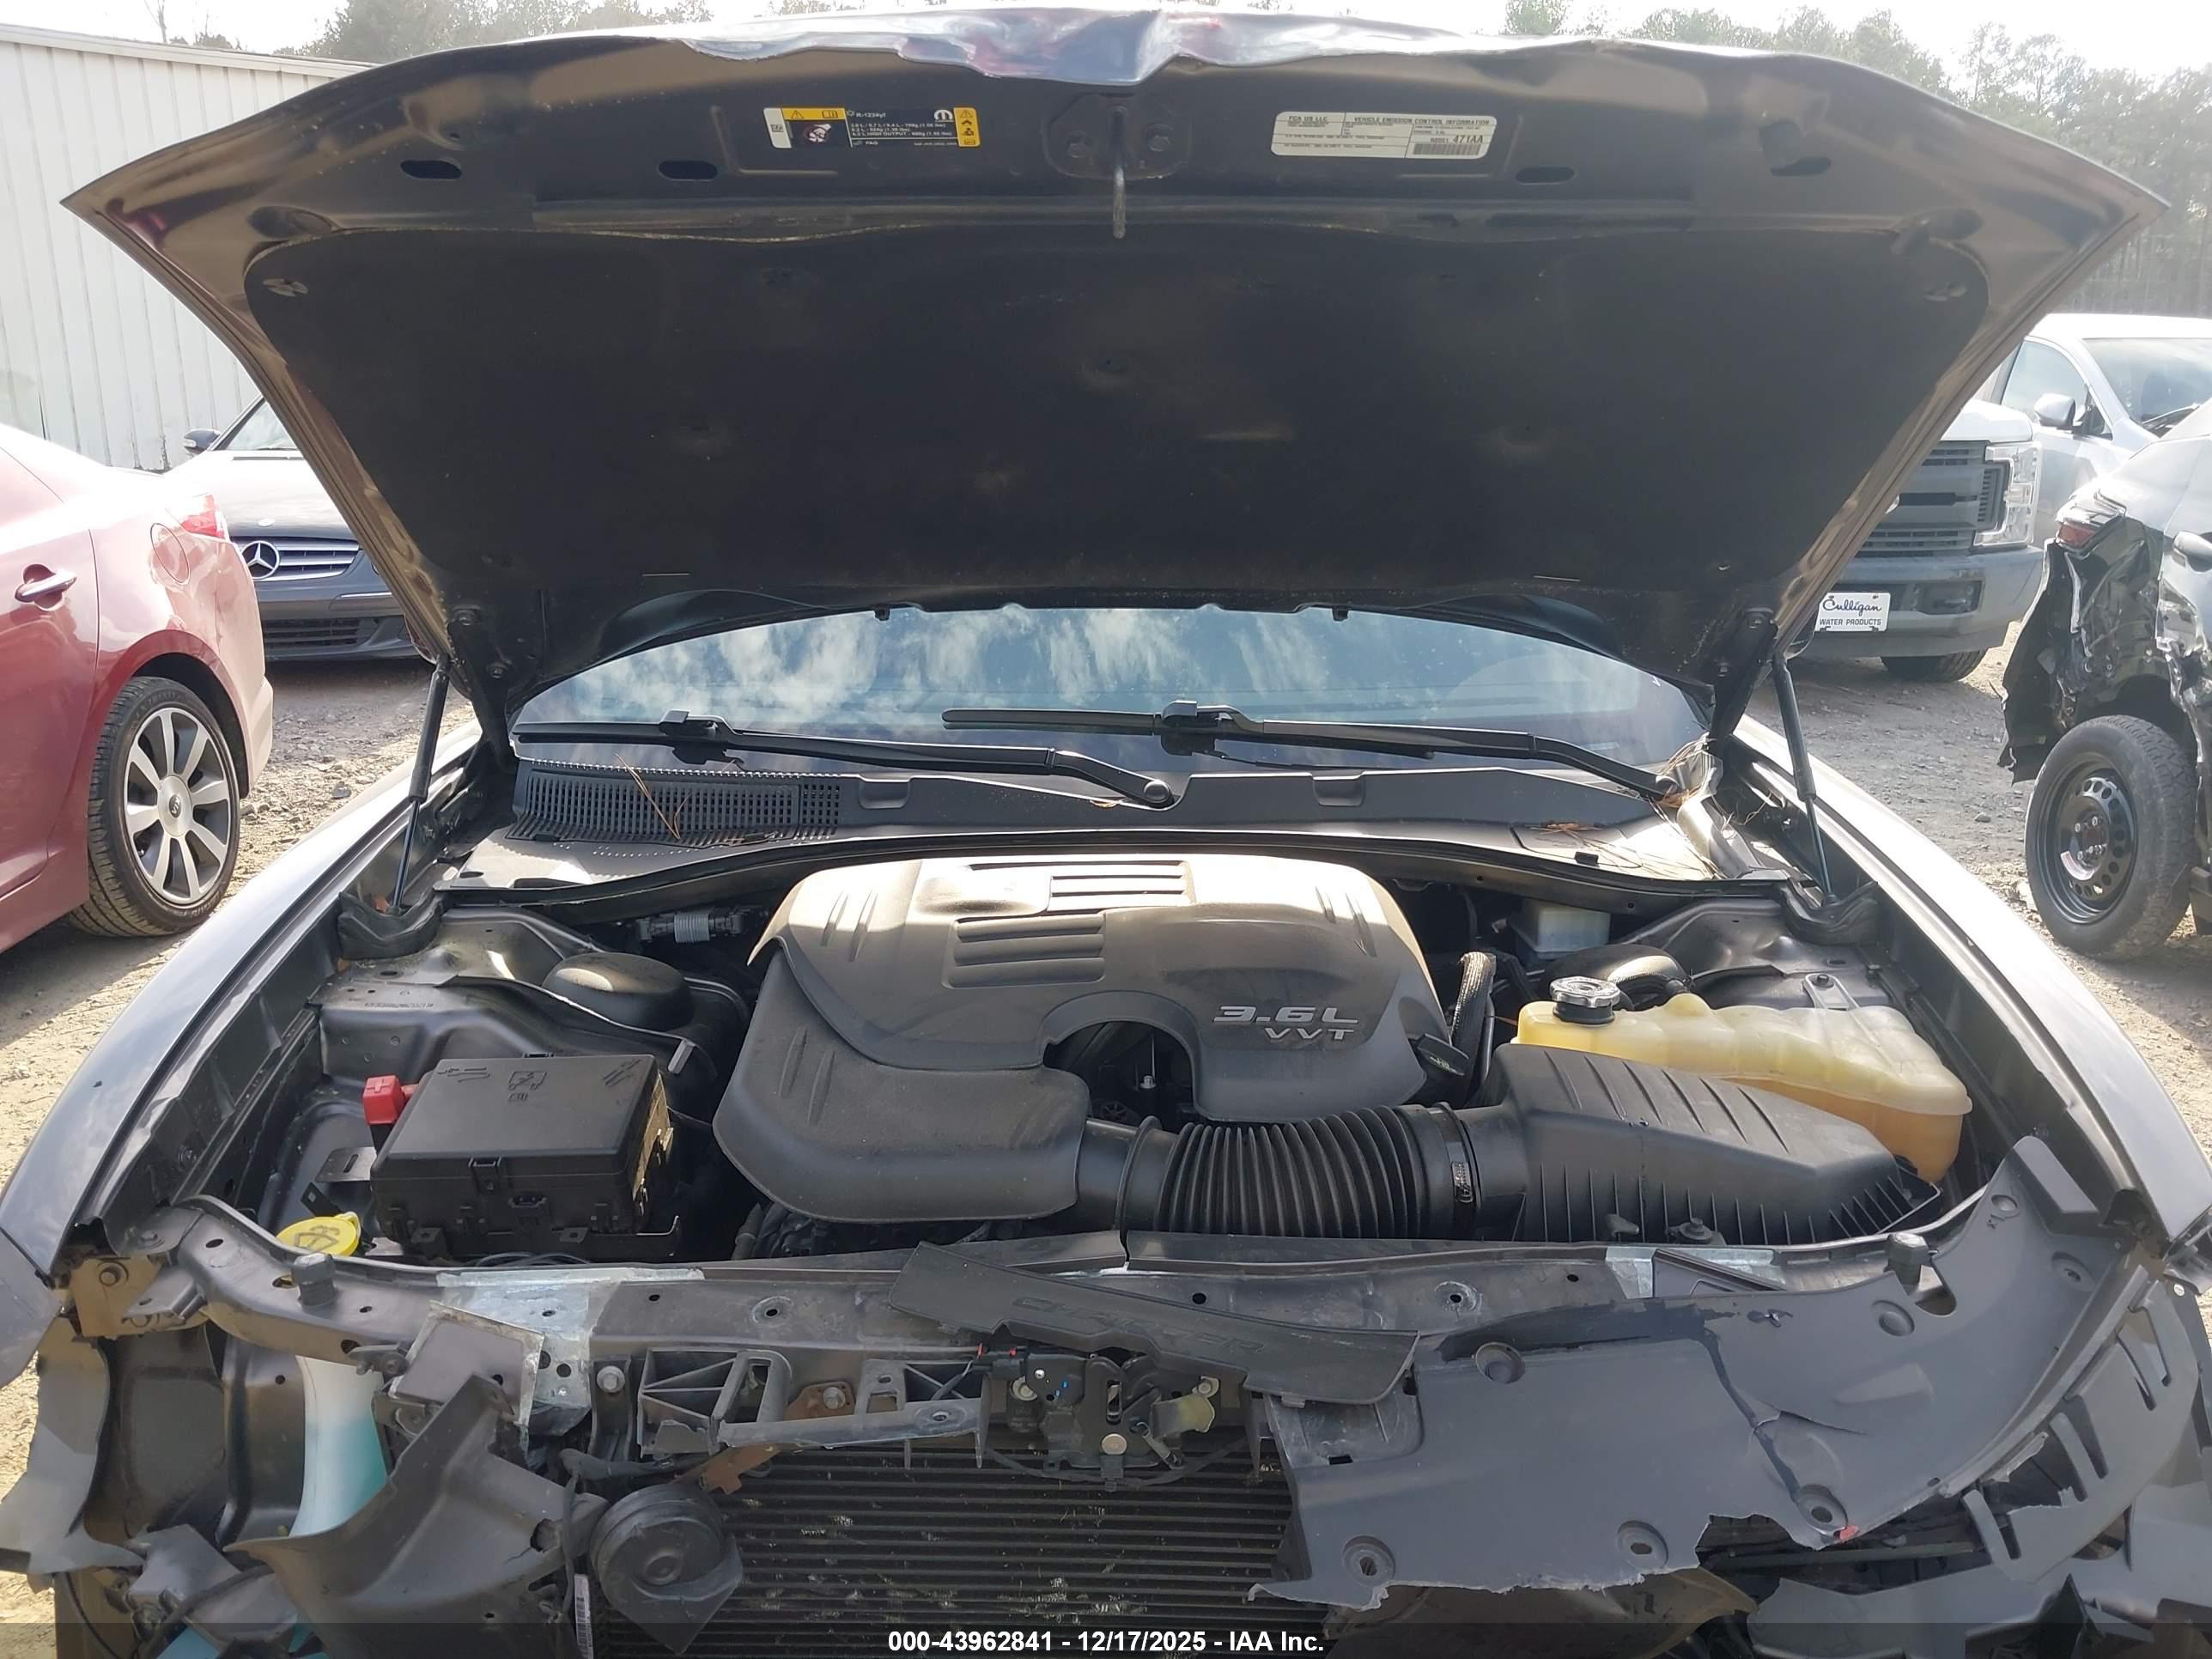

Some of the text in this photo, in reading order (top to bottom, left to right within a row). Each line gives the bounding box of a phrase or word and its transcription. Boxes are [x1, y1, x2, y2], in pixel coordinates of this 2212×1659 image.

[1452, 134, 1484, 144] 471AA
[1822, 599, 1882, 617] Culligan
[1213, 1005, 1358, 1024] 3.6L
[1264, 1027, 1354, 1041] VVT
